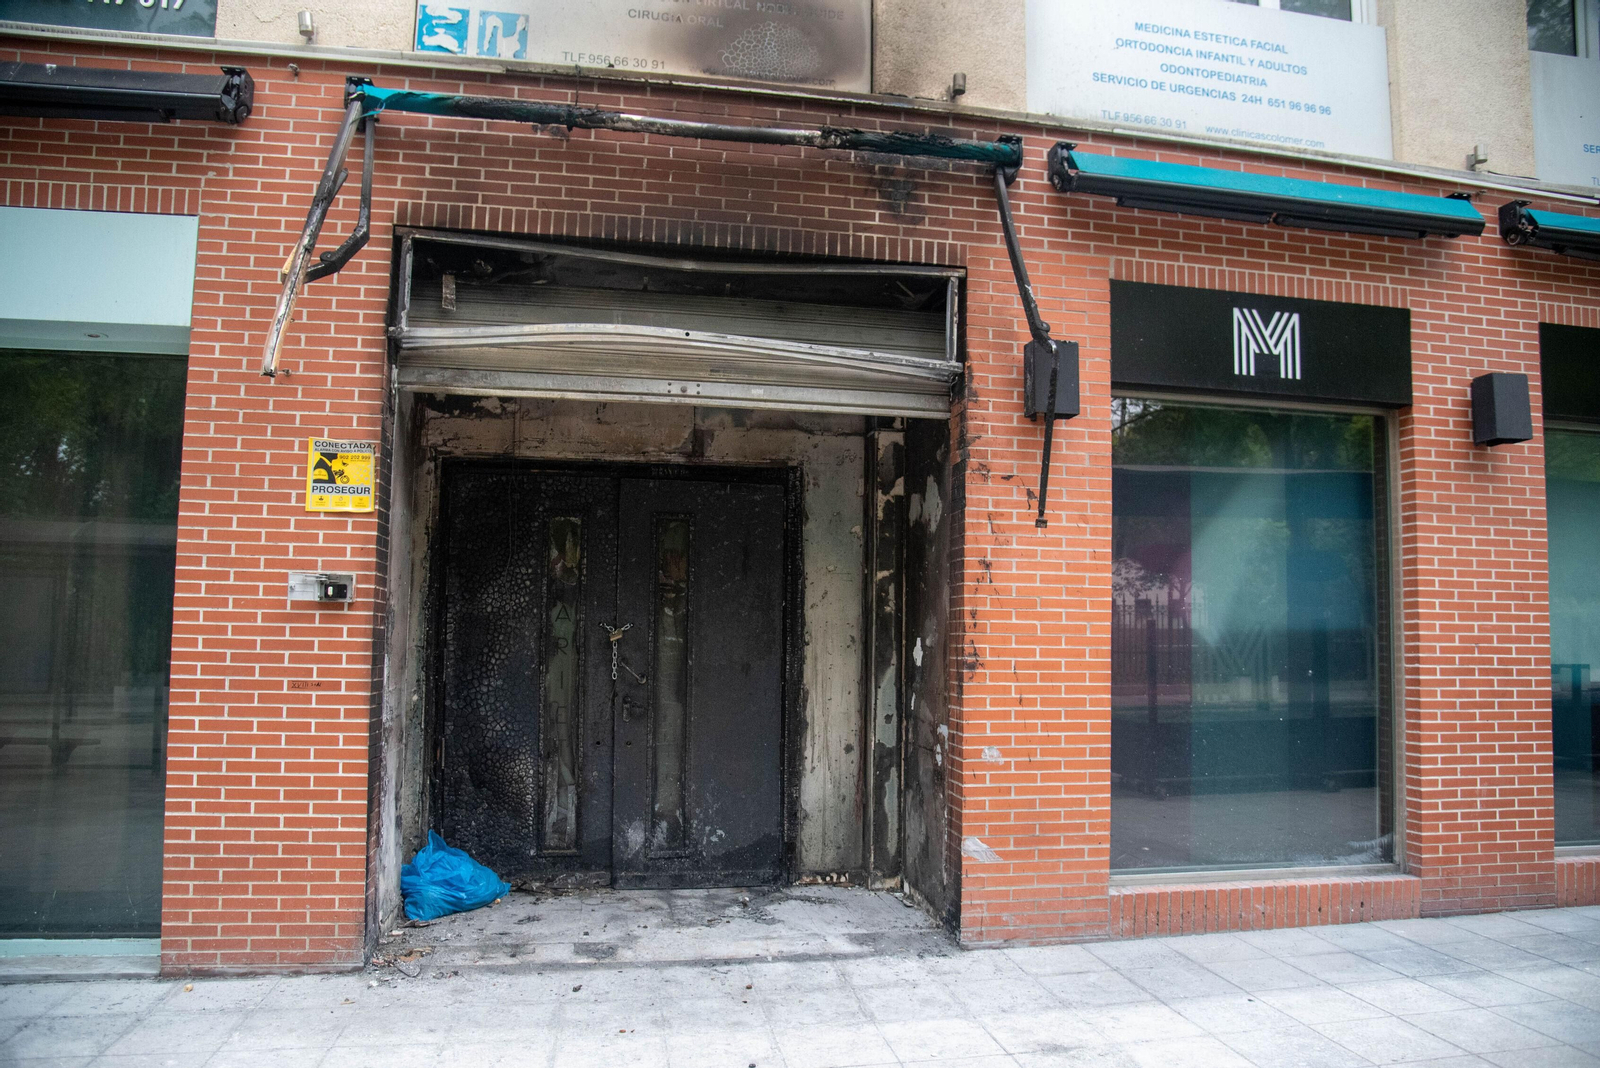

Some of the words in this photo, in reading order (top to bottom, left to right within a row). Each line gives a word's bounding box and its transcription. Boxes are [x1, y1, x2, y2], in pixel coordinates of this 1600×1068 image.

[687, 14, 724, 28] ORAL
[1135, 22, 1191, 39] MEDICINA
[1194, 31, 1247, 47] ESTETICA
[1250, 40, 1288, 54] FACIAL
[614, 56, 629, 66] 66
[633, 58, 648, 68] 30
[651, 60, 665, 70] 91
[1115, 38, 1193, 58] ORTODONCIA
[1196, 50, 1246, 66] INFANTIL
[1248, 58, 1256, 67] Y
[1258, 60, 1308, 76] ADULTOS
[1160, 63, 1268, 87] ODONTOPEDIATRIA
[1092, 72, 1148, 89] SERVICIO
[1151, 80, 1167, 92] DE
[1169, 83, 1236, 101] URGENCIAS
[1241, 93, 1263, 105] 24H
[1267, 97, 1286, 109] 651
[1288, 101, 1302, 112] 96
[1303, 103, 1317, 114] 96
[1318, 105, 1332, 116] 96
[1144, 115, 1157, 126] 66
[1160, 117, 1173, 127] 30
[1175, 119, 1187, 129] 91
[1232, 307, 1302, 380] M
[314, 441, 372, 449] CONECTADA
[312, 485, 371, 494] PROSEGUR
